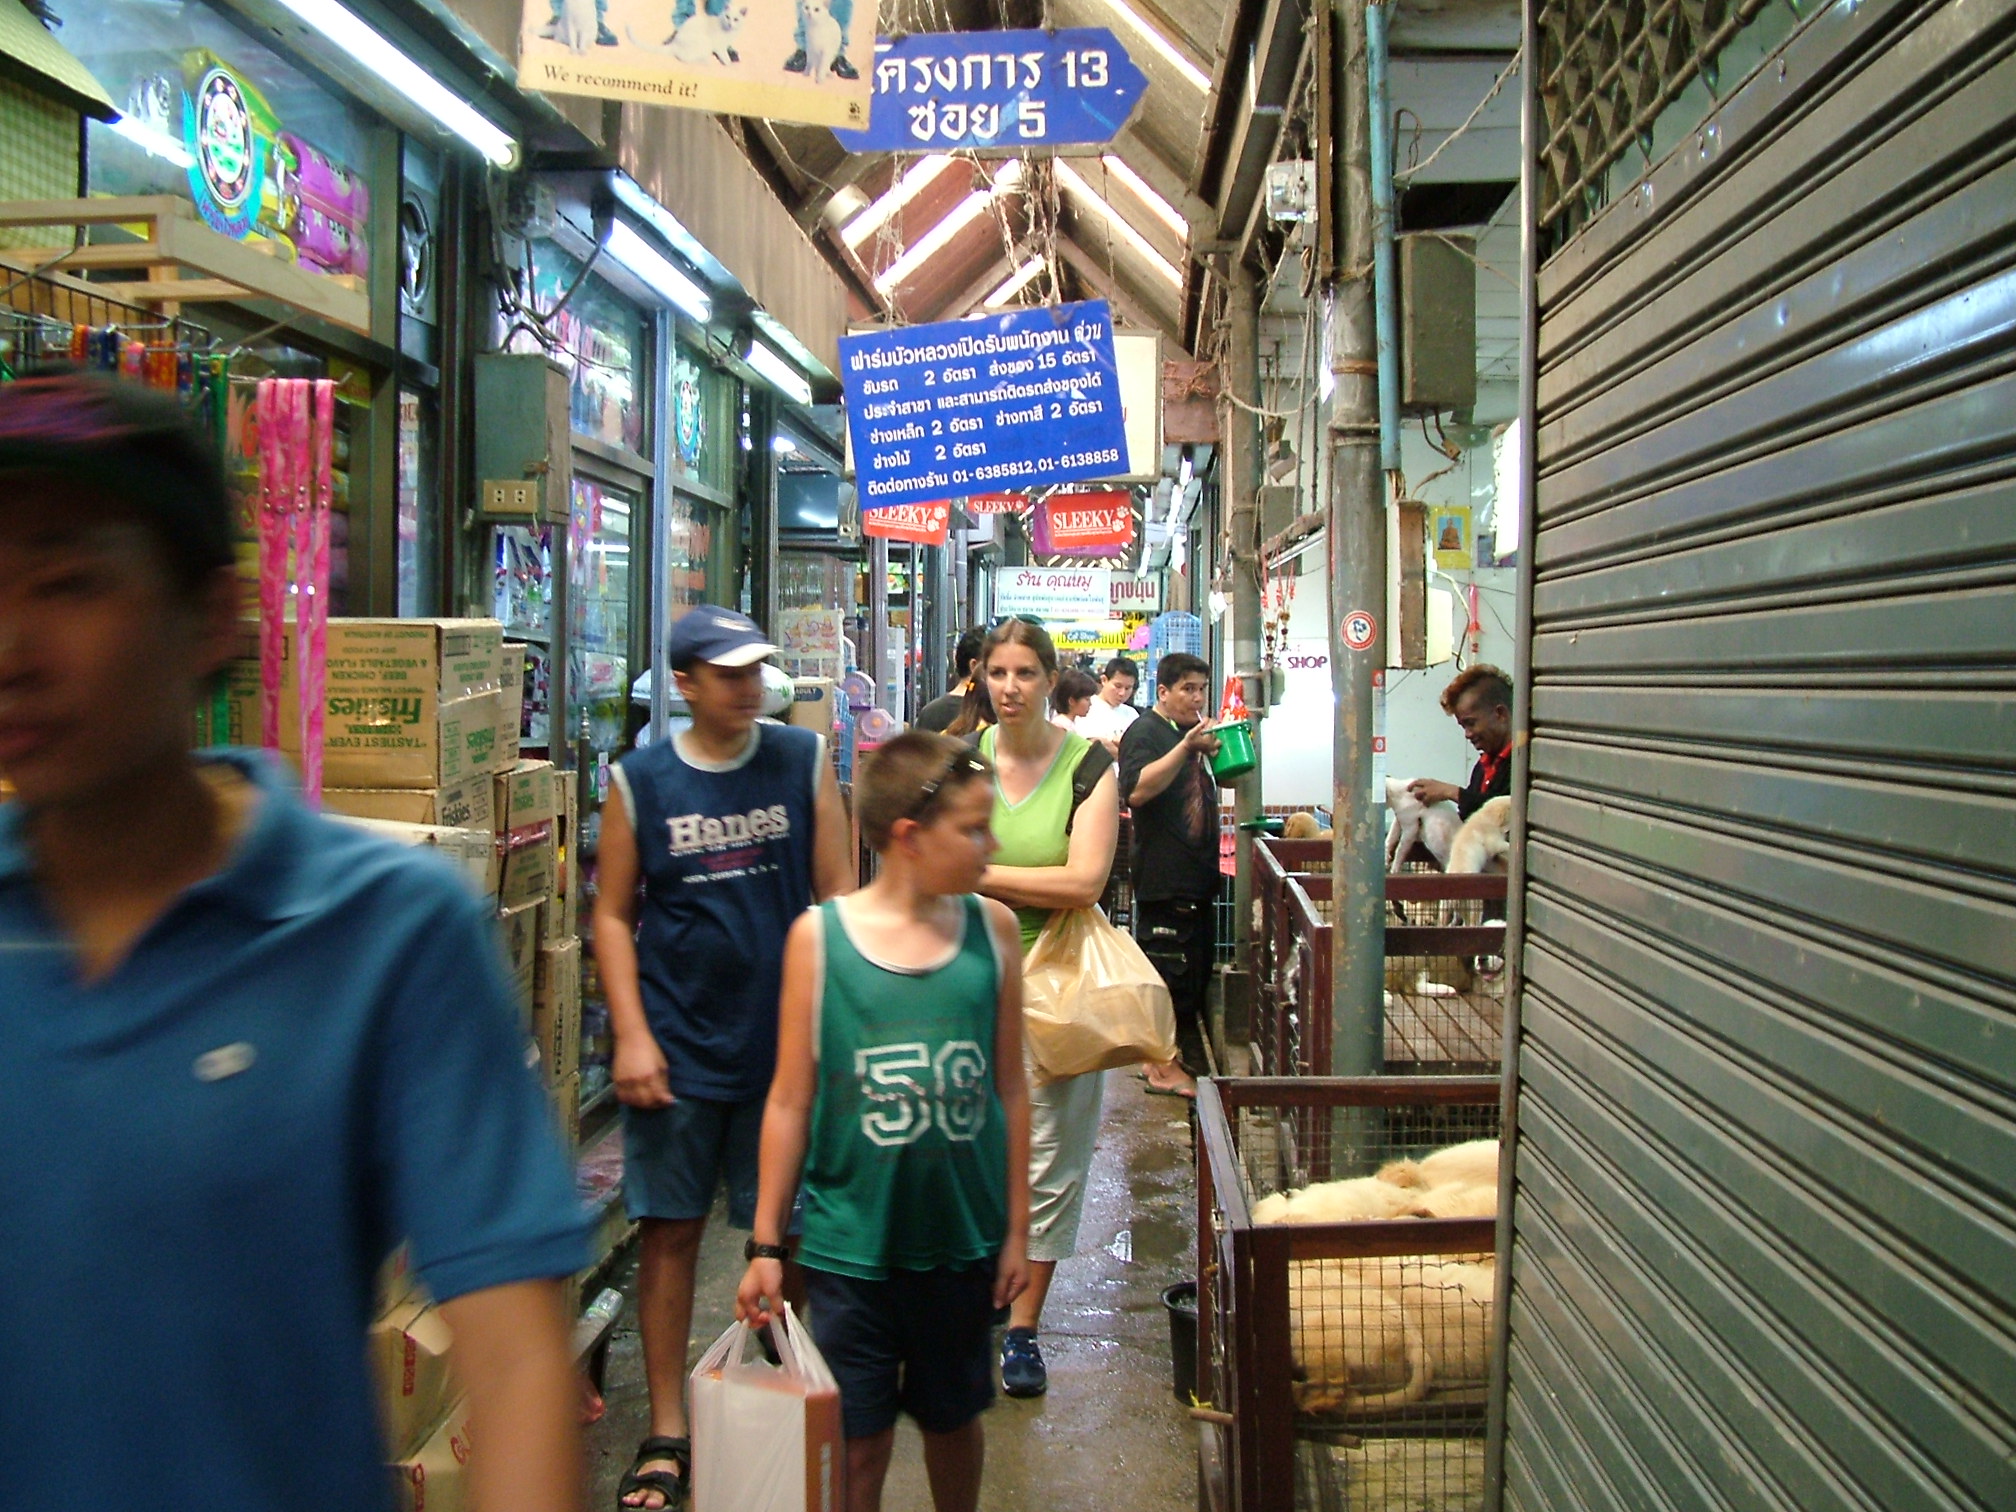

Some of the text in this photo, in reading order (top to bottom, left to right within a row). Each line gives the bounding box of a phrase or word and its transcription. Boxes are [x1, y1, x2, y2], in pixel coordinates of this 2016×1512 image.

[544, 66, 699, 98] We recommend it!
[873, 44, 1109, 94] ครงการ 13
[907, 100, 1046, 142] ซอย 5
[850, 322, 1102, 371] ฟาร์มบัวหลวงเปิดรับพนักงาน ด่วน
[863, 348, 1097, 395] ขับรถ 2 อัตรา ส่งของ 15 อัตรา
[864, 399, 931, 420] ประจำสาขา
[870, 399, 1102, 445] ช่างเหล็ก 2 อัตรา ช่างทาสี 2 อัตรา
[873, 441, 986, 470] ช่างไม้ 2 อัตรา
[868, 471, 949, 497] ติดต่อทางร้าน
[868, 502, 932, 527] SLEEKY
[973, 501, 1015, 514] SLEEKY
[1053, 509, 1116, 532] SLEEKY
[1016, 570, 1041, 587] ร้าน
[1288, 656, 1328, 669] SHOP
[665, 804, 790, 853] Hanes
